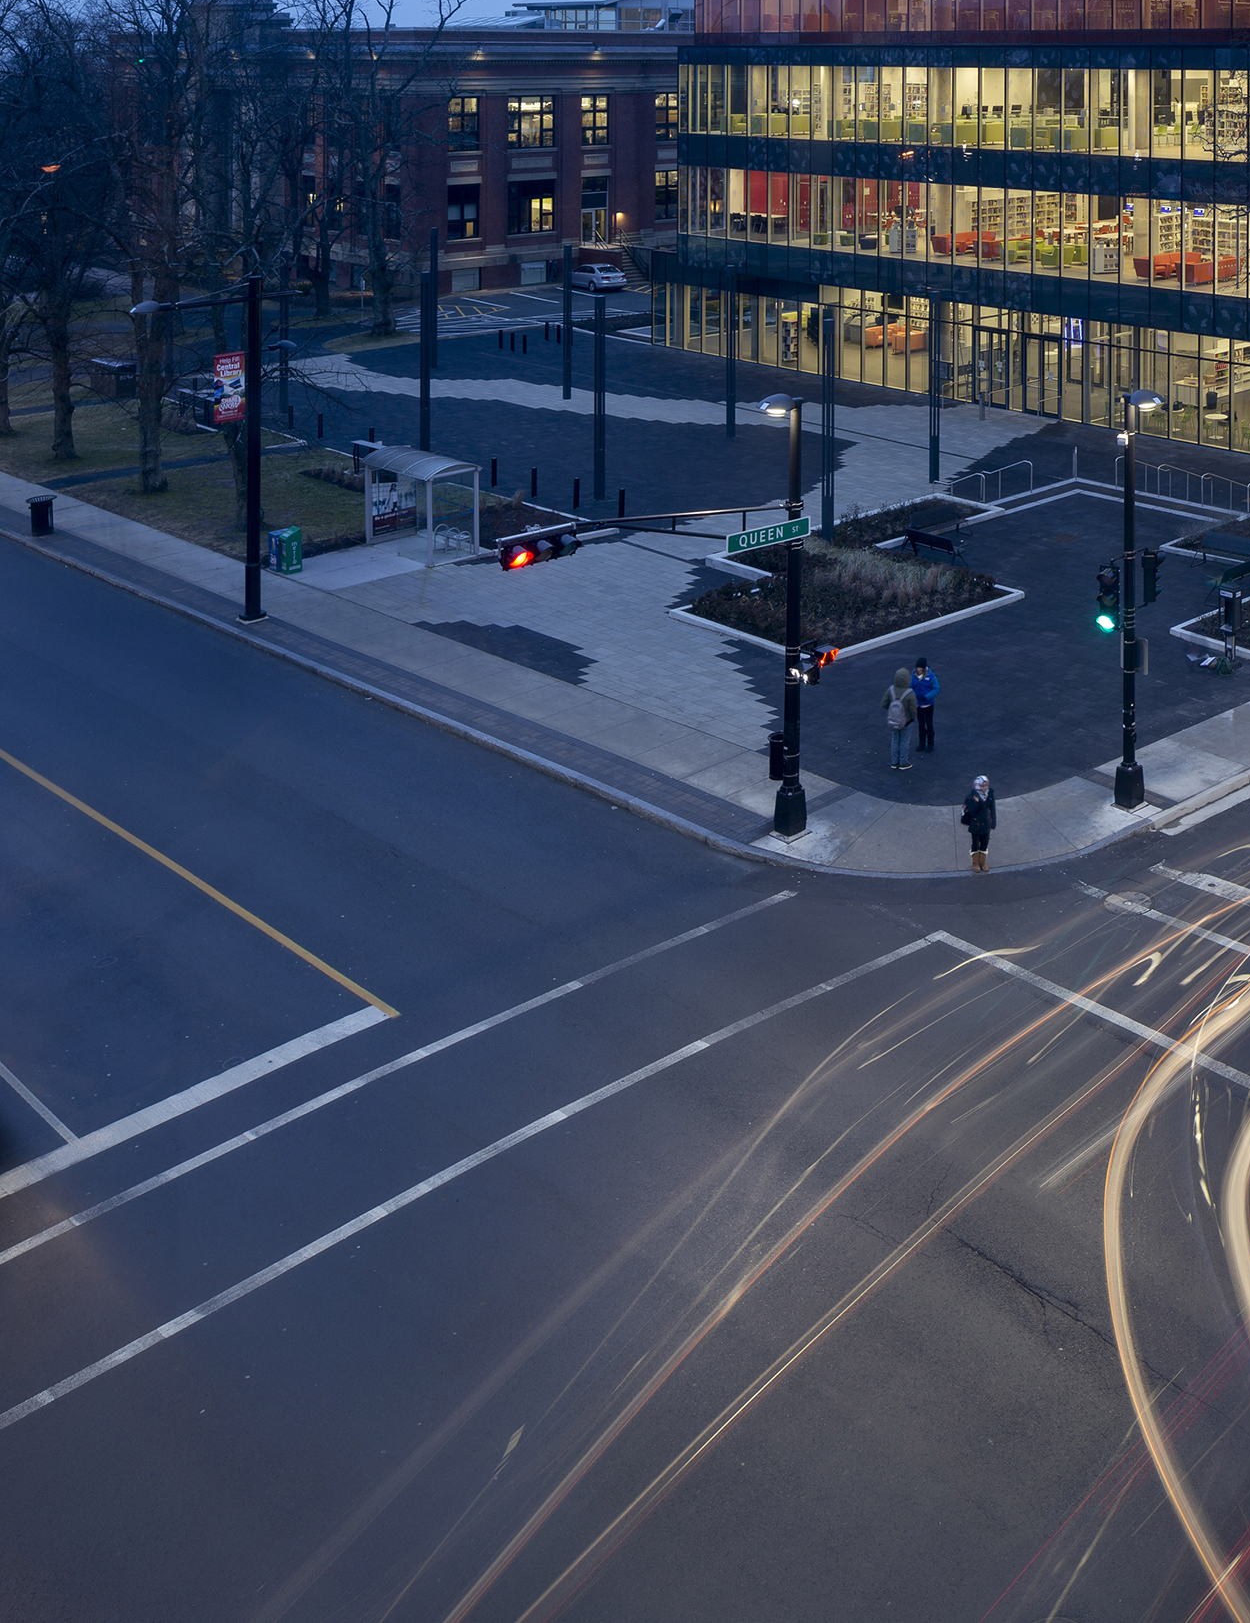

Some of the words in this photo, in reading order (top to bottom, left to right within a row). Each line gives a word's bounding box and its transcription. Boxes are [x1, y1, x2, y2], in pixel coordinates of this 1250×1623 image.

[216, 362, 240, 371] Central
[220, 369, 242, 377] Library
[738, 526, 784, 548] QUEEN
[791, 525, 799, 533] ST
